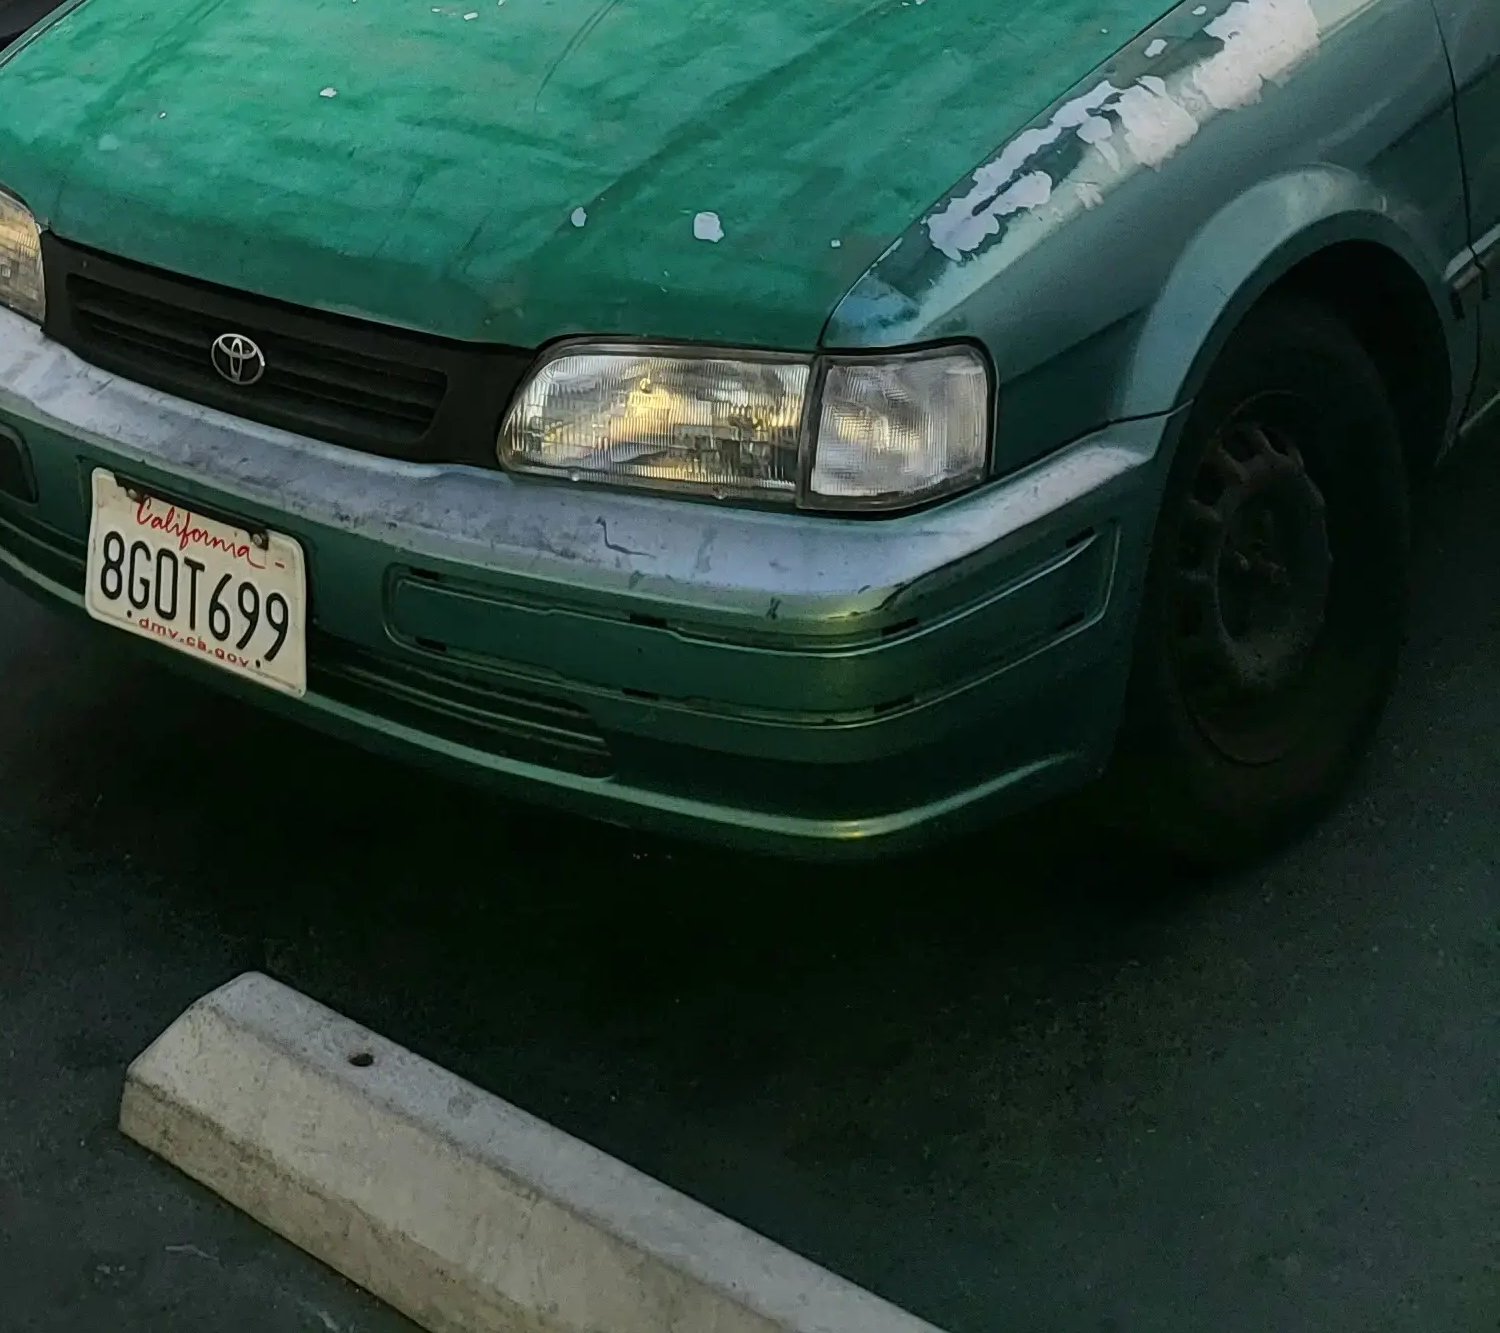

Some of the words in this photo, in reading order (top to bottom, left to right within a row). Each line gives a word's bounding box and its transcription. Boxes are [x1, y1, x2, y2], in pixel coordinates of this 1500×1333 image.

[137, 495, 265, 569] California
[100, 530, 289, 662] 8GOT699
[138, 617, 250, 668] dmv.ca.gov
